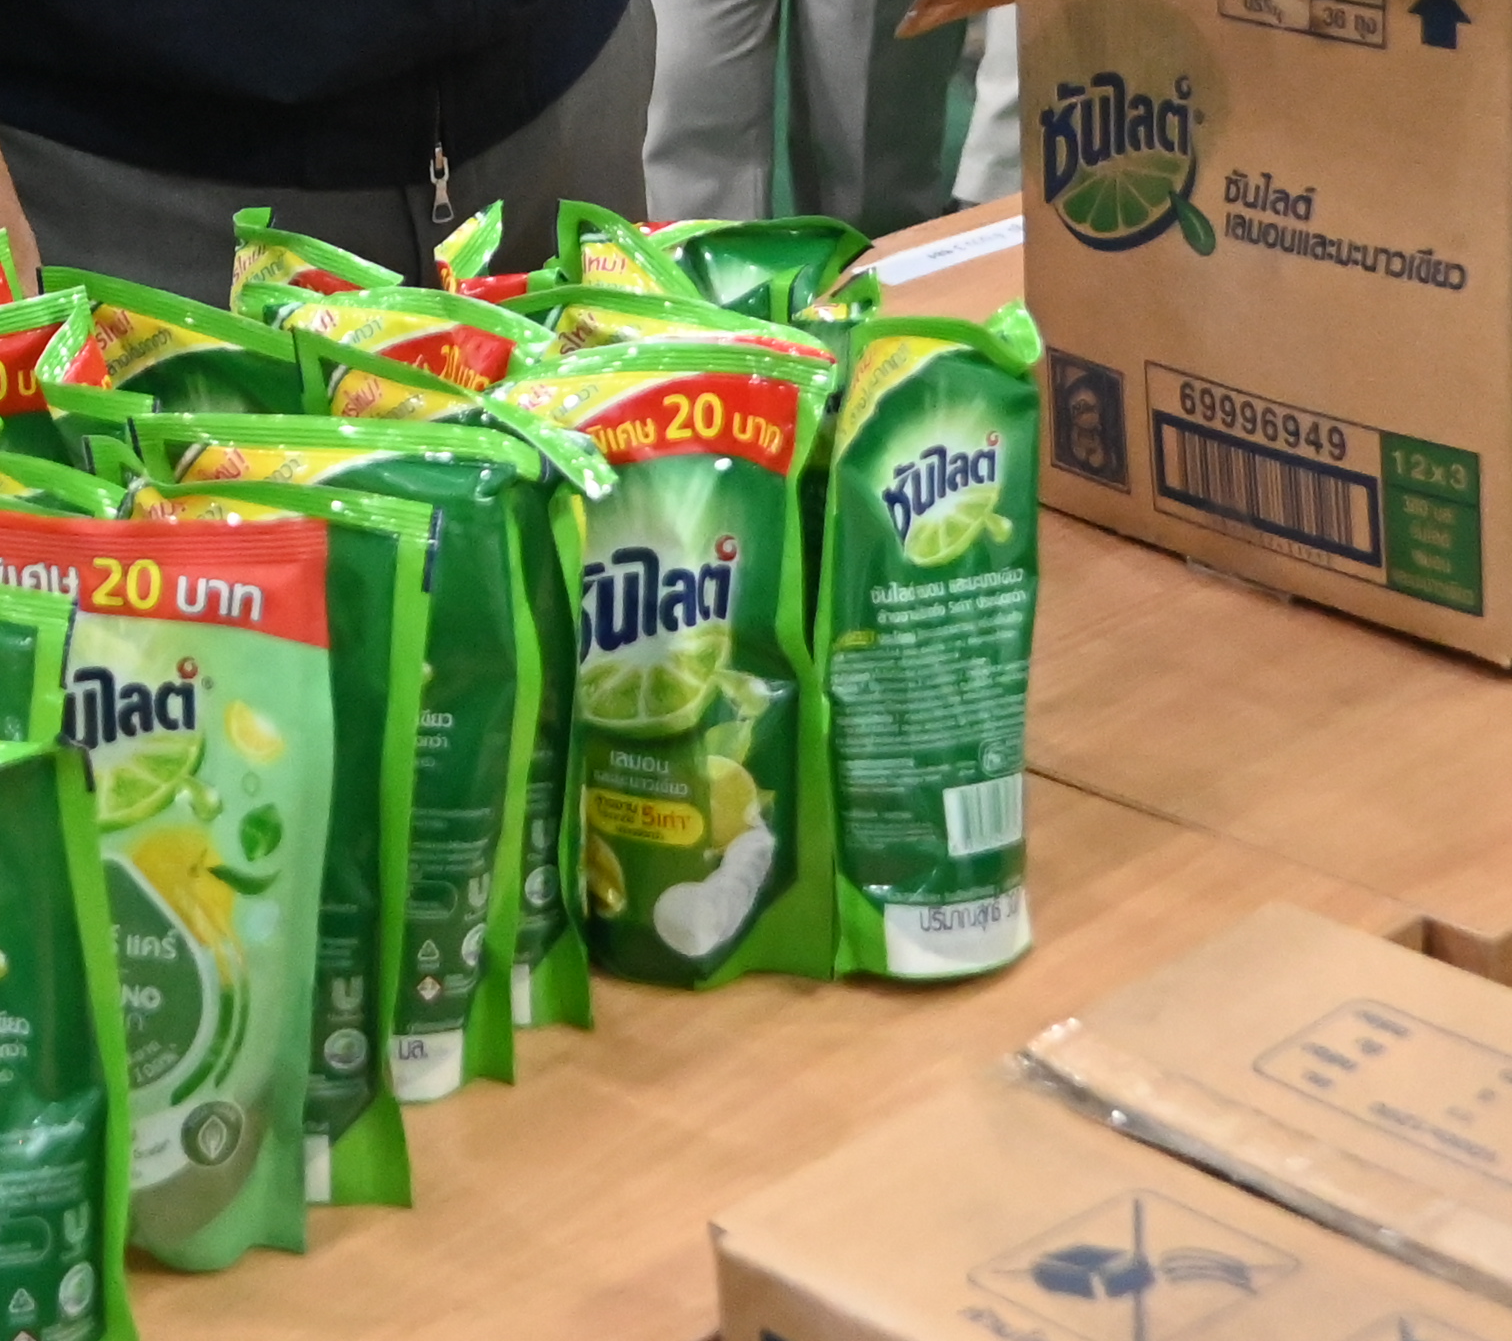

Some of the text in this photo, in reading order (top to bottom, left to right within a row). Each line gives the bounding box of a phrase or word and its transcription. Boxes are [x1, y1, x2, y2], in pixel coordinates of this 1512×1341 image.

[1224, 212, 1467, 291] เลมอนและมะนาวเขียว
[662, 392, 724, 440] 20
[733, 411, 784, 455] บาท
[1179, 379, 1347, 462] 69996949
[1391, 449, 1468, 491] 12x3
[91, 557, 163, 611] 20
[176, 574, 263, 623] บาท
